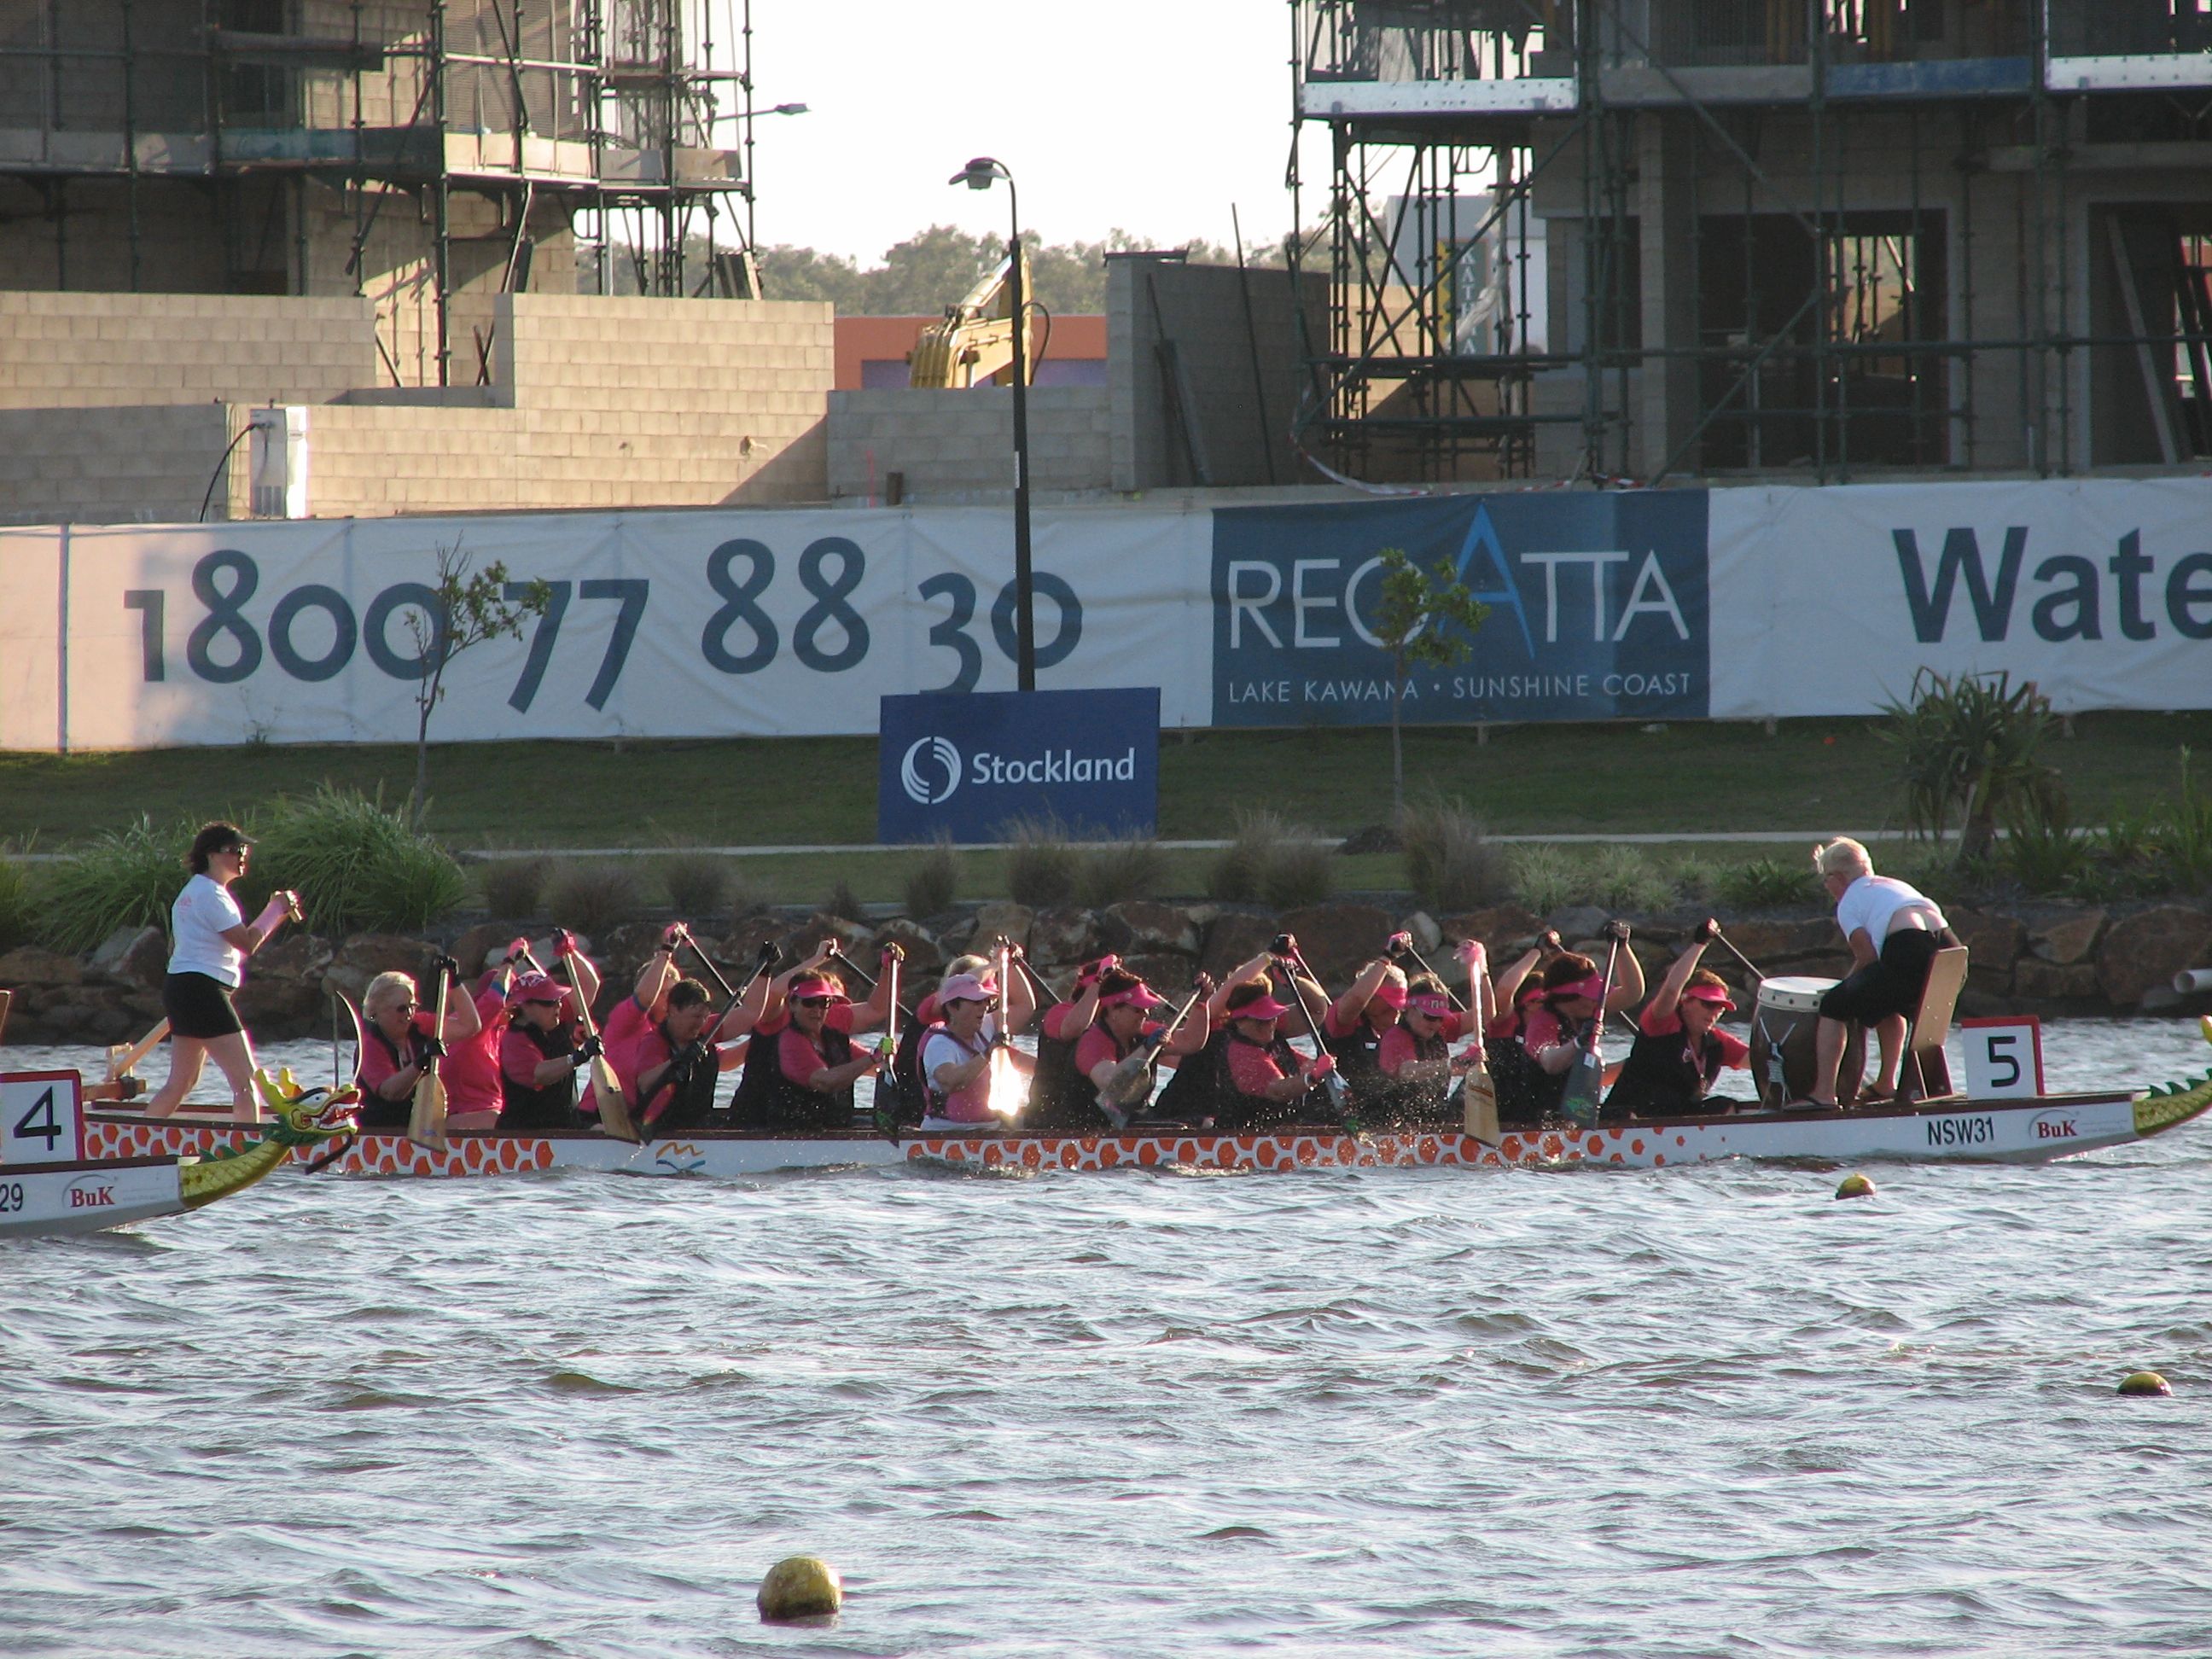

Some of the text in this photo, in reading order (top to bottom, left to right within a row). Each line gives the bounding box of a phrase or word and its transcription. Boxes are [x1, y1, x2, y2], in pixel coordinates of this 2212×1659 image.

[1228, 503, 1690, 659] REGATTA
[1892, 527, 2212, 643] Wate
[125, 537, 1082, 713] 1800 77 88 30
[1229, 672, 1691, 703] LAKE KAWANA SUNSHINE COAST
[971, 747, 1135, 784] Stockland
[1988, 1035, 2021, 1088] 5
[13, 1085, 61, 1151] 4
[1927, 1116, 1994, 1146] NSW31
[2036, 1120, 2078, 1139] BuK
[0, 1182, 24, 1213] 29
[70, 1185, 115, 1208] BuK
